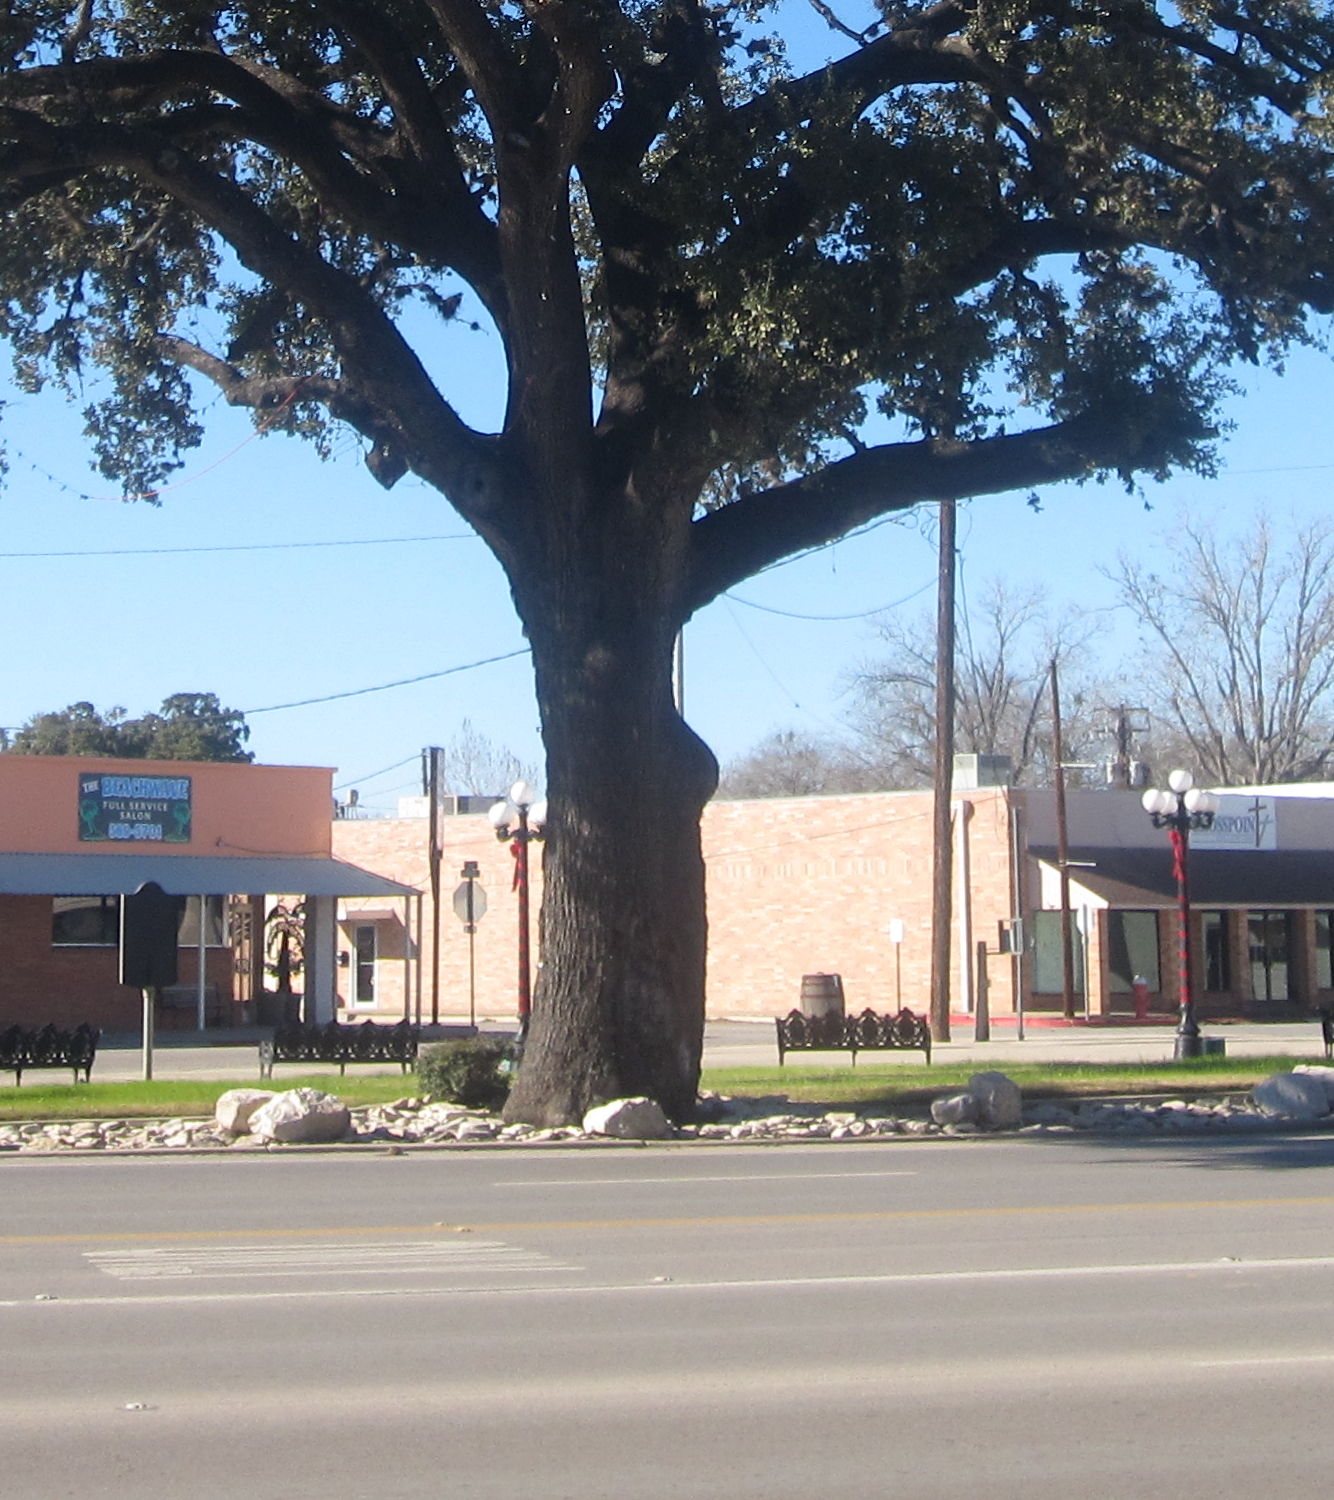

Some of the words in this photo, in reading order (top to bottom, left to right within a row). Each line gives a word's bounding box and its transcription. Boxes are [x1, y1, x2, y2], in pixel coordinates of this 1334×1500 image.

[83, 780, 100, 793] THE
[100, 776, 189, 800] BEACHWAVE
[102, 801, 126, 810] FULL
[128, 802, 168, 812] SERVICE
[119, 811, 152, 821] SALON
